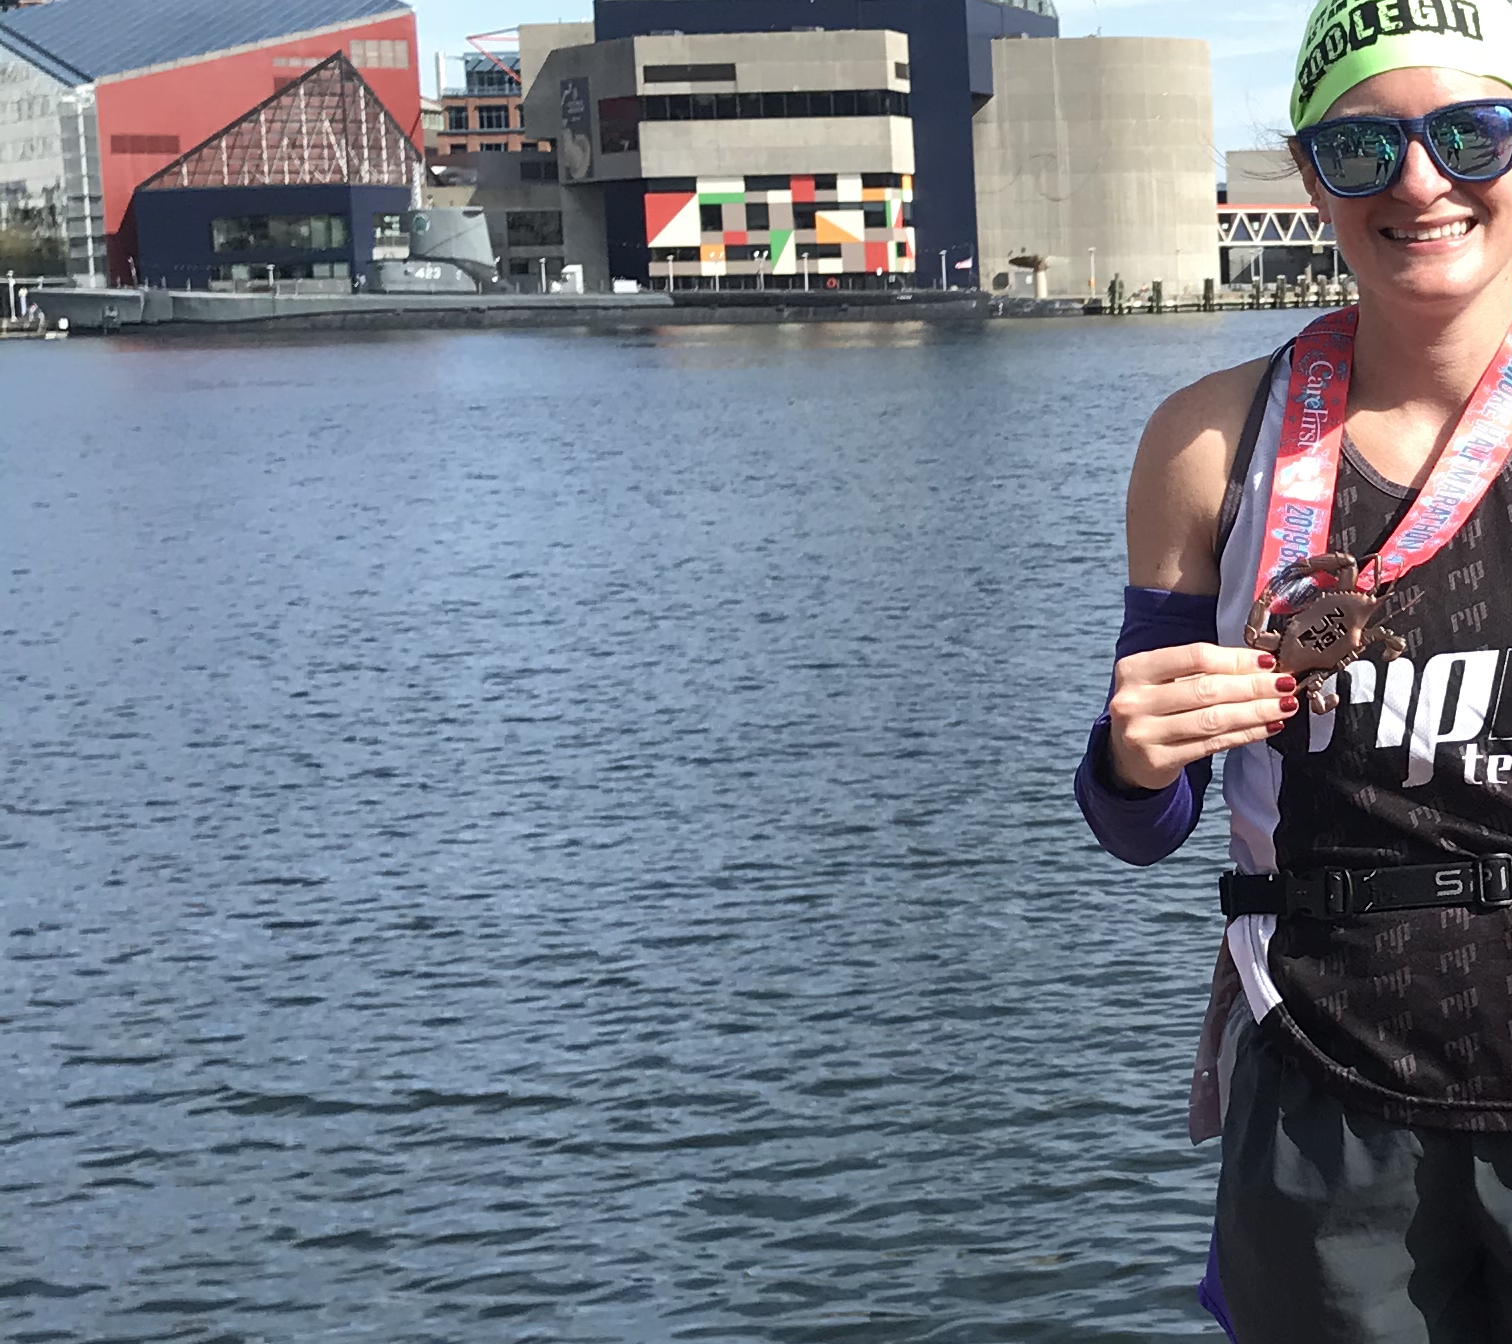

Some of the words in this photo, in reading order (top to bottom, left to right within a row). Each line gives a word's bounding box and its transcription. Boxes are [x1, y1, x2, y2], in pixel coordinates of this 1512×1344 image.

[1297, 360, 1335, 454] CareFirst
[1458, 418, 1511, 471] HALF
[1281, 505, 1315, 546] 2019
[1399, 464, 1479, 549] MARATHON
[1448, 560, 1485, 591] rip
[1297, 606, 1345, 647] RUN
[1451, 601, 1489, 633] rip
[1312, 623, 1348, 654] 13.1
